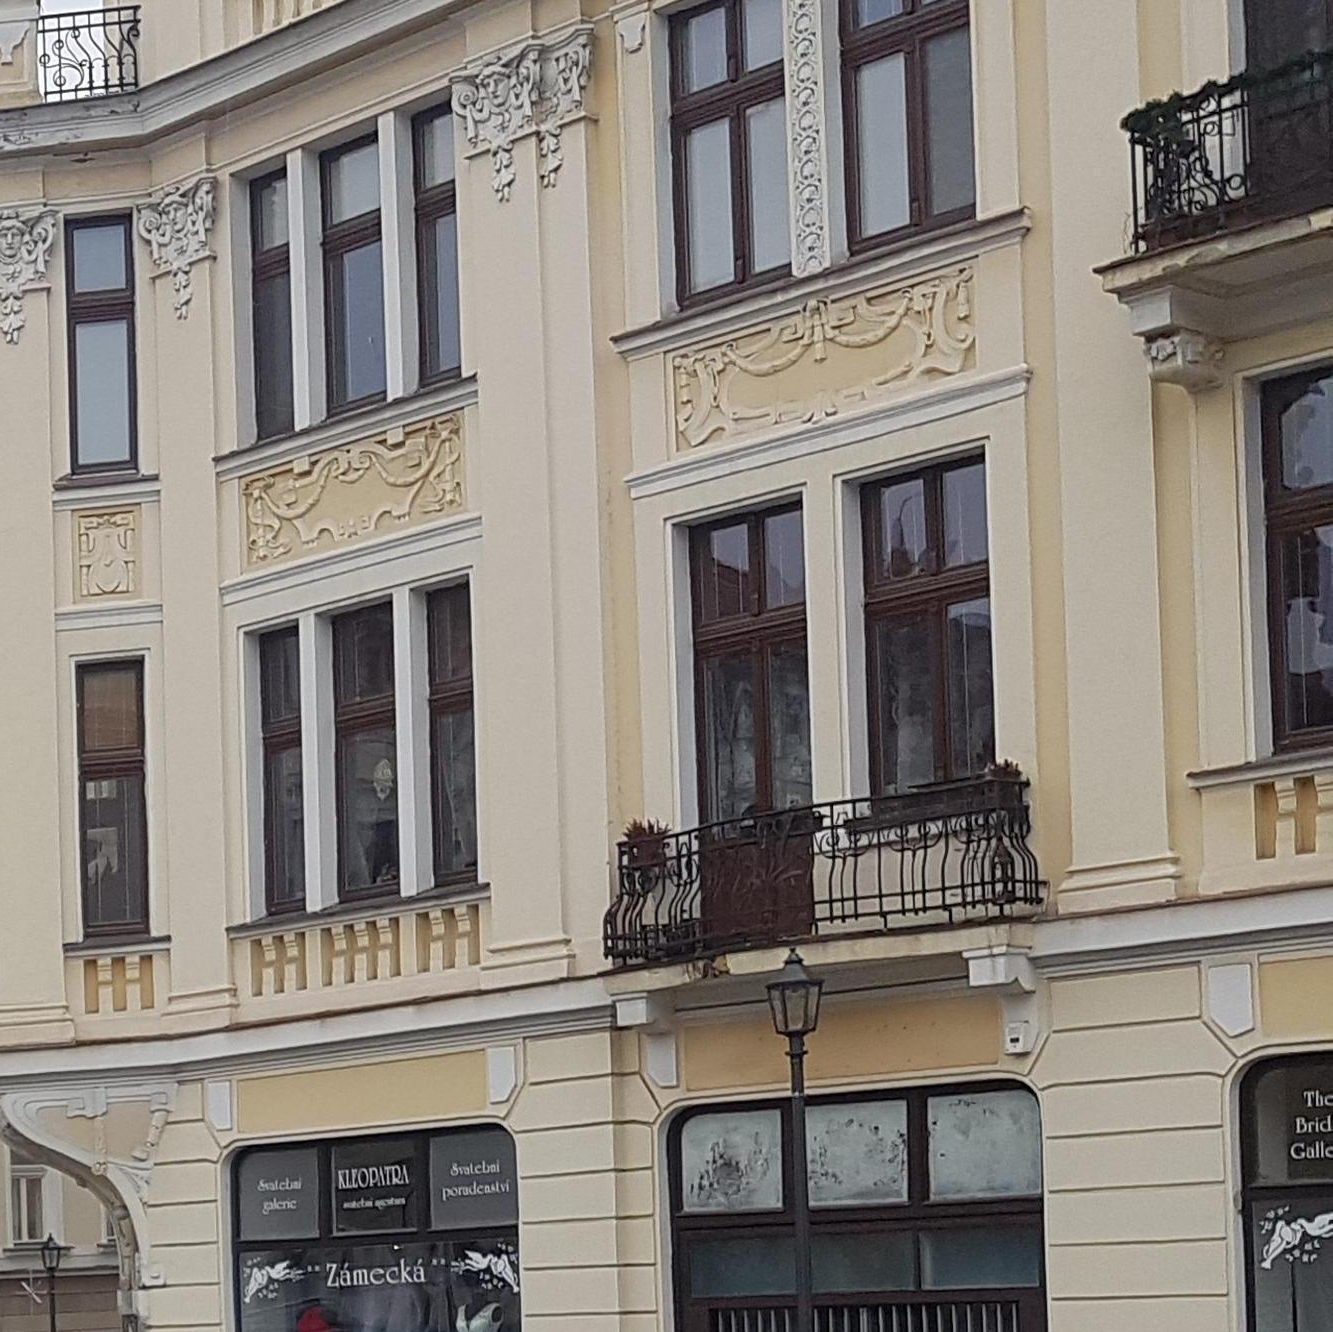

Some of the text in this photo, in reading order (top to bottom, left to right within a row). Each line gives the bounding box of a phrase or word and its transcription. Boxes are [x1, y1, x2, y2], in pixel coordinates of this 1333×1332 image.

[337, 1164, 409, 1190] KLEOPATRA
[442, 1177, 511, 1202] poradenství
[262, 1198, 297, 1216] galerie
[326, 1259, 426, 1288] Zámecká
